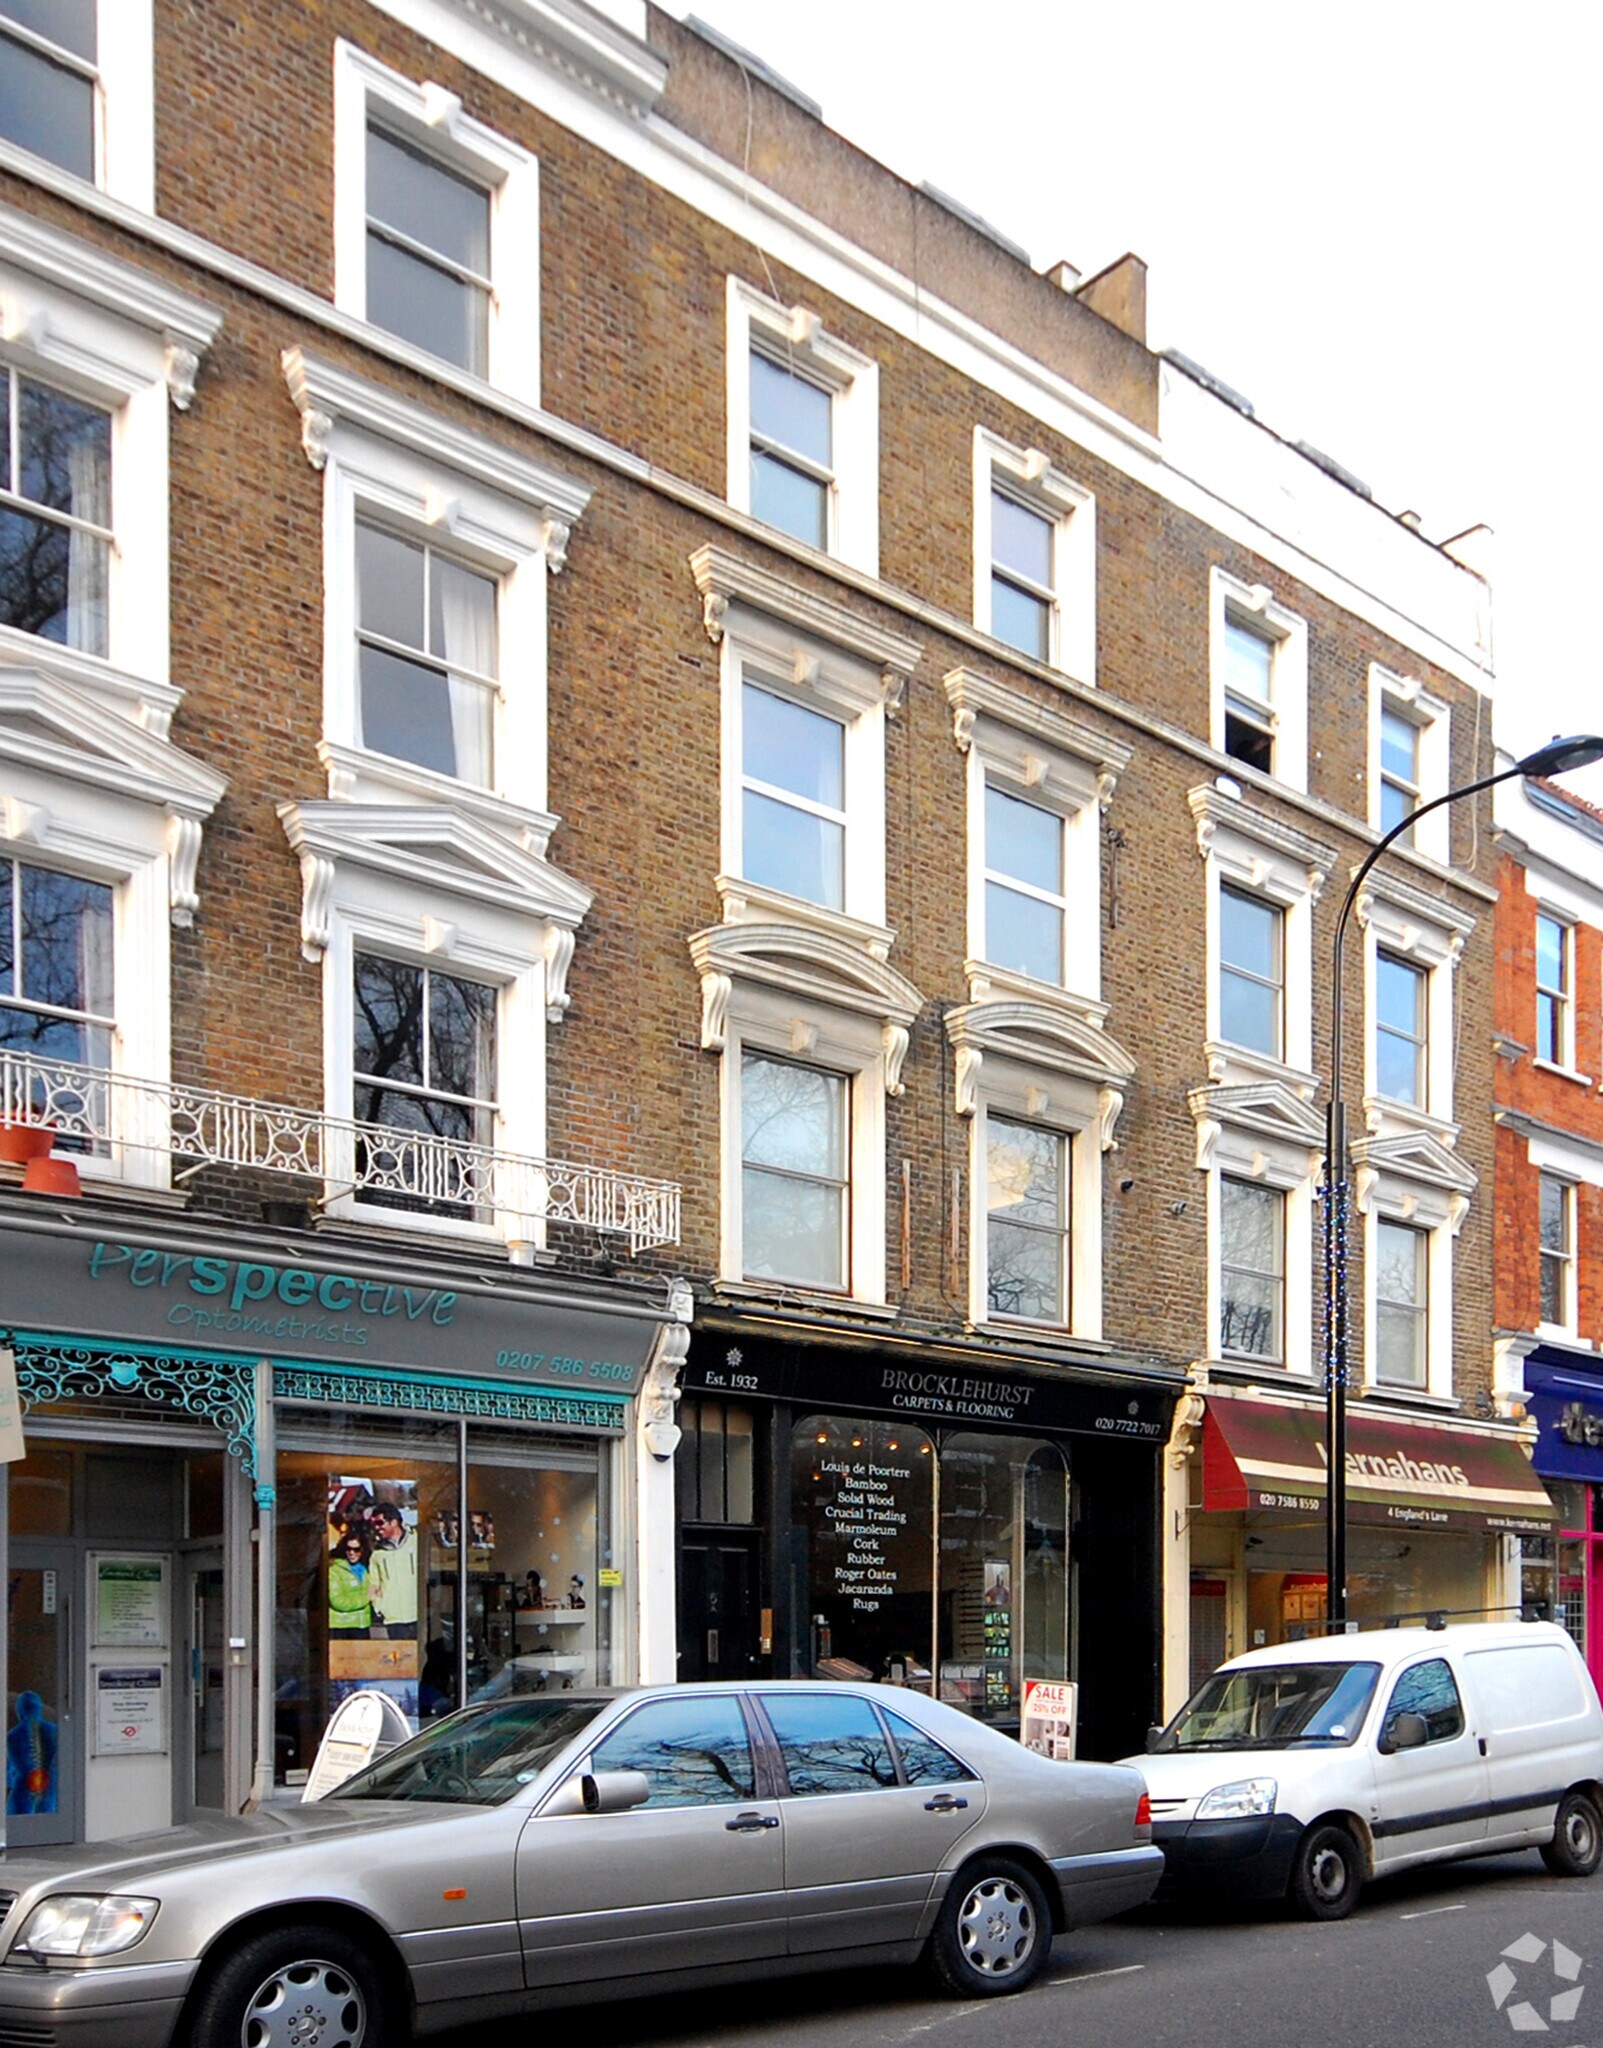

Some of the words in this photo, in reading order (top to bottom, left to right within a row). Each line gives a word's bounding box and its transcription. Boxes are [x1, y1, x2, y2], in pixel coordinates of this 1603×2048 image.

[88, 1242, 457, 1326] Perspective
[167, 1302, 368, 1346] Optometrists
[496, 1350, 545, 1371] 0207
[549, 1355, 584, 1376] 586
[589, 1361, 634, 1382] 5508
[705, 1370, 727, 1387] Est.
[731, 1373, 758, 1390] 1932
[881, 1368, 1035, 1405] BROCKLEHURST
[892, 1394, 944, 1411] CARPETS
[945, 1400, 954, 1412] &
[956, 1401, 1014, 1419] FLOORING
[1095, 1417, 1115, 1430] 020
[1116, 1419, 1139, 1433] 7722
[1140, 1422, 1161, 1435] 7017
[821, 1460, 850, 1474] Louis
[853, 1462, 866, 1475] de
[868, 1464, 911, 1479] Poortere
[845, 1477, 888, 1491] Bamboo
[837, 1491, 864, 1505] Solid
[866, 1493, 895, 1507] Wood
[1260, 1493, 1276, 1506] 020
[1278, 1495, 1298, 1509] 7586
[825, 1506, 864, 1519] Crucial
[866, 1508, 907, 1525] Trading
[1388, 1506, 1394, 1517] 4
[1394, 1507, 1430, 1521] England's
[1430, 1511, 1449, 1523] Lane
[835, 1521, 897, 1536] Marmoleum
[853, 1538, 880, 1551] Cork
[847, 1553, 886, 1566] Rubber
[834, 1567, 866, 1582] Roger
[867, 1568, 898, 1581] Oates
[837, 1582, 894, 1596] Jacaranda
[853, 1598, 880, 1612] Rugs
[1035, 1685, 1065, 1701] SALE
[1051, 1704, 1068, 1715] OFF
